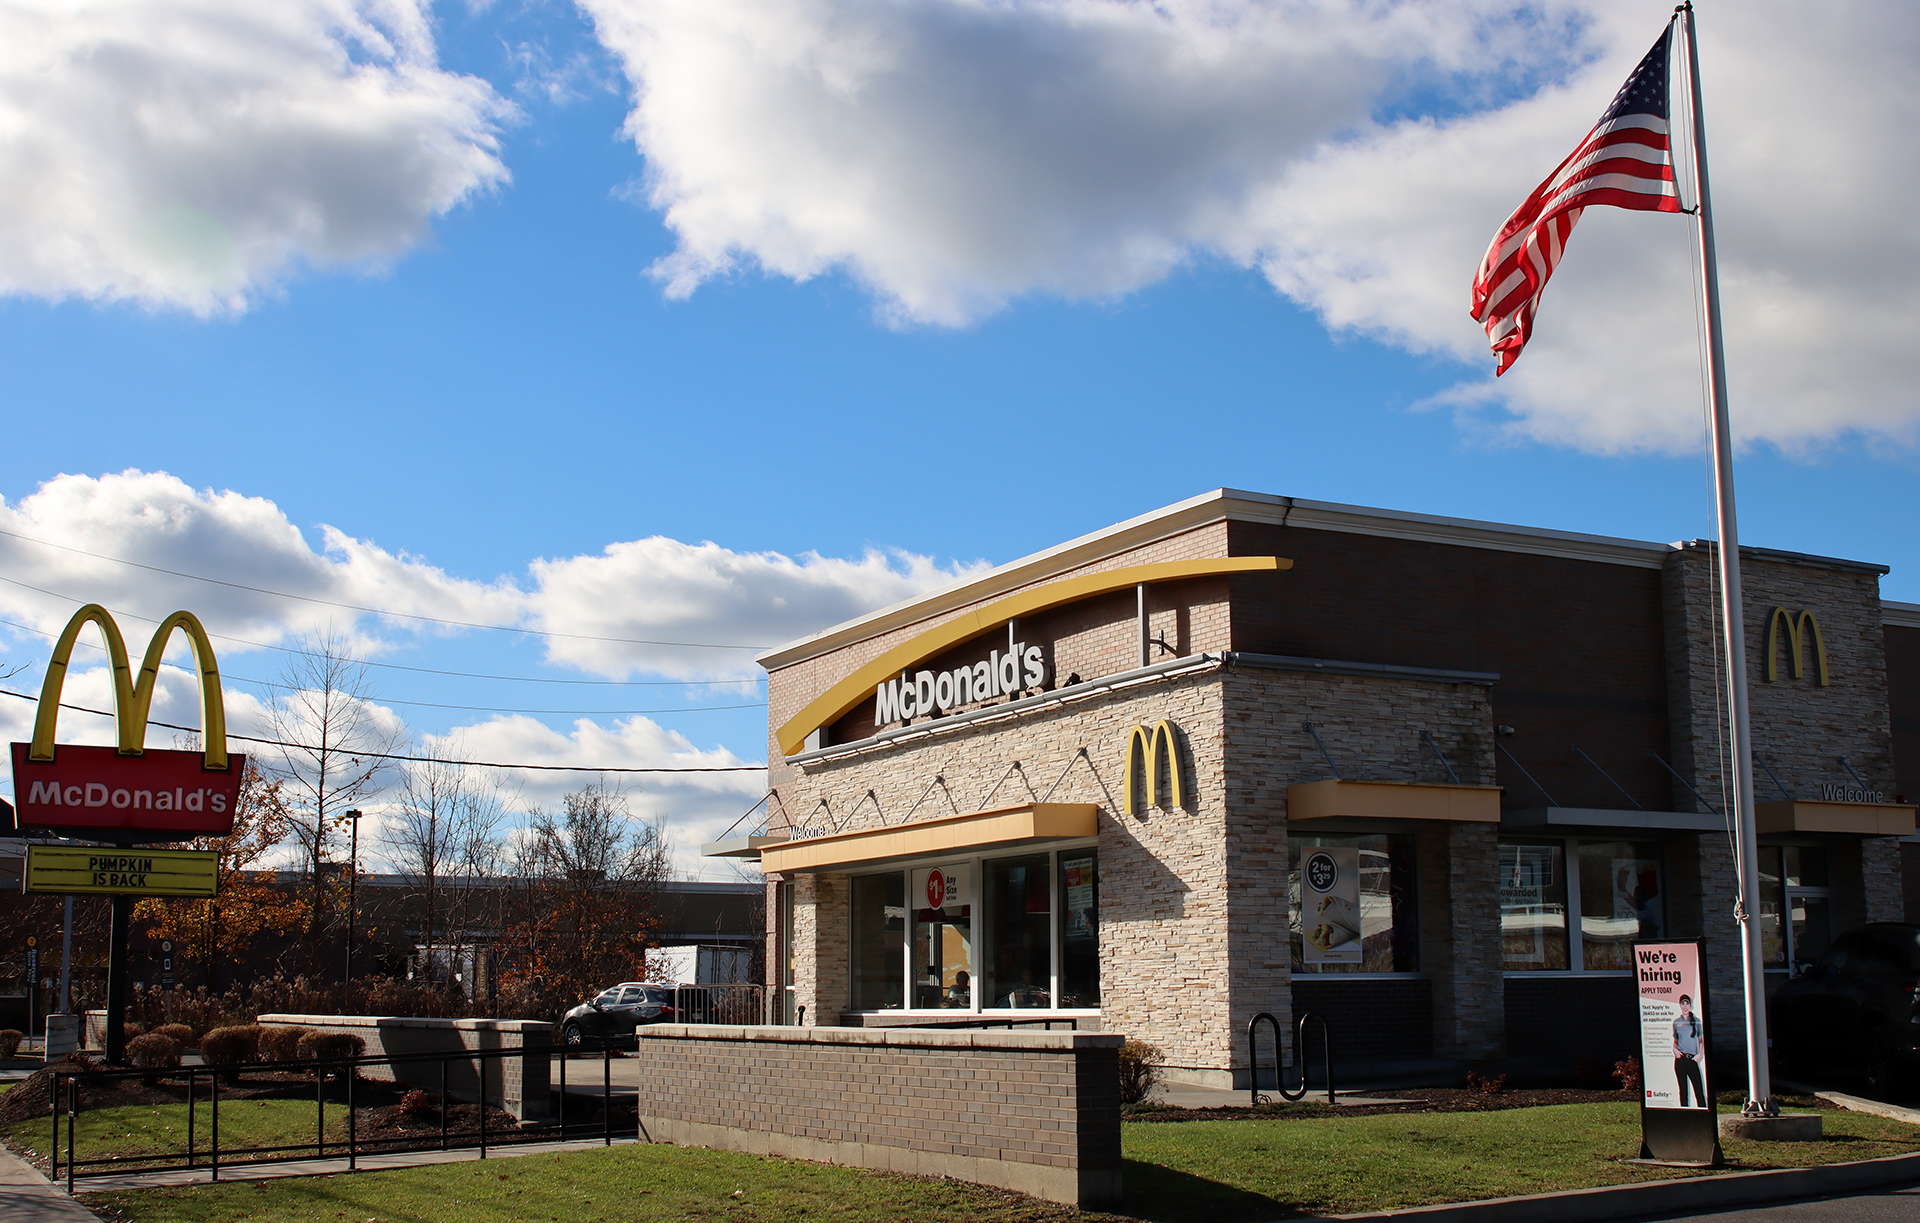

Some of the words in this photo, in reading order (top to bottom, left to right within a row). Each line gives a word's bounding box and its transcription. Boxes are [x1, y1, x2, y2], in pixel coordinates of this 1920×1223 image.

[874, 641, 1044, 727] McDonald's
[27, 780, 227, 813] McDonald's
[1821, 783, 1883, 803] Welcome
[789, 825, 825, 841] Welcome
[89, 857, 152, 872] PUMPKIN
[1312, 861, 1320, 873] 2
[1320, 862, 1332, 871] for
[93, 873, 107, 886] IS
[110, 873, 147, 887] BACK
[946, 876, 956, 886] Any
[946, 885, 957, 895] Size
[1638, 950, 1677, 964] We're
[1640, 967, 1682, 985] hiring
